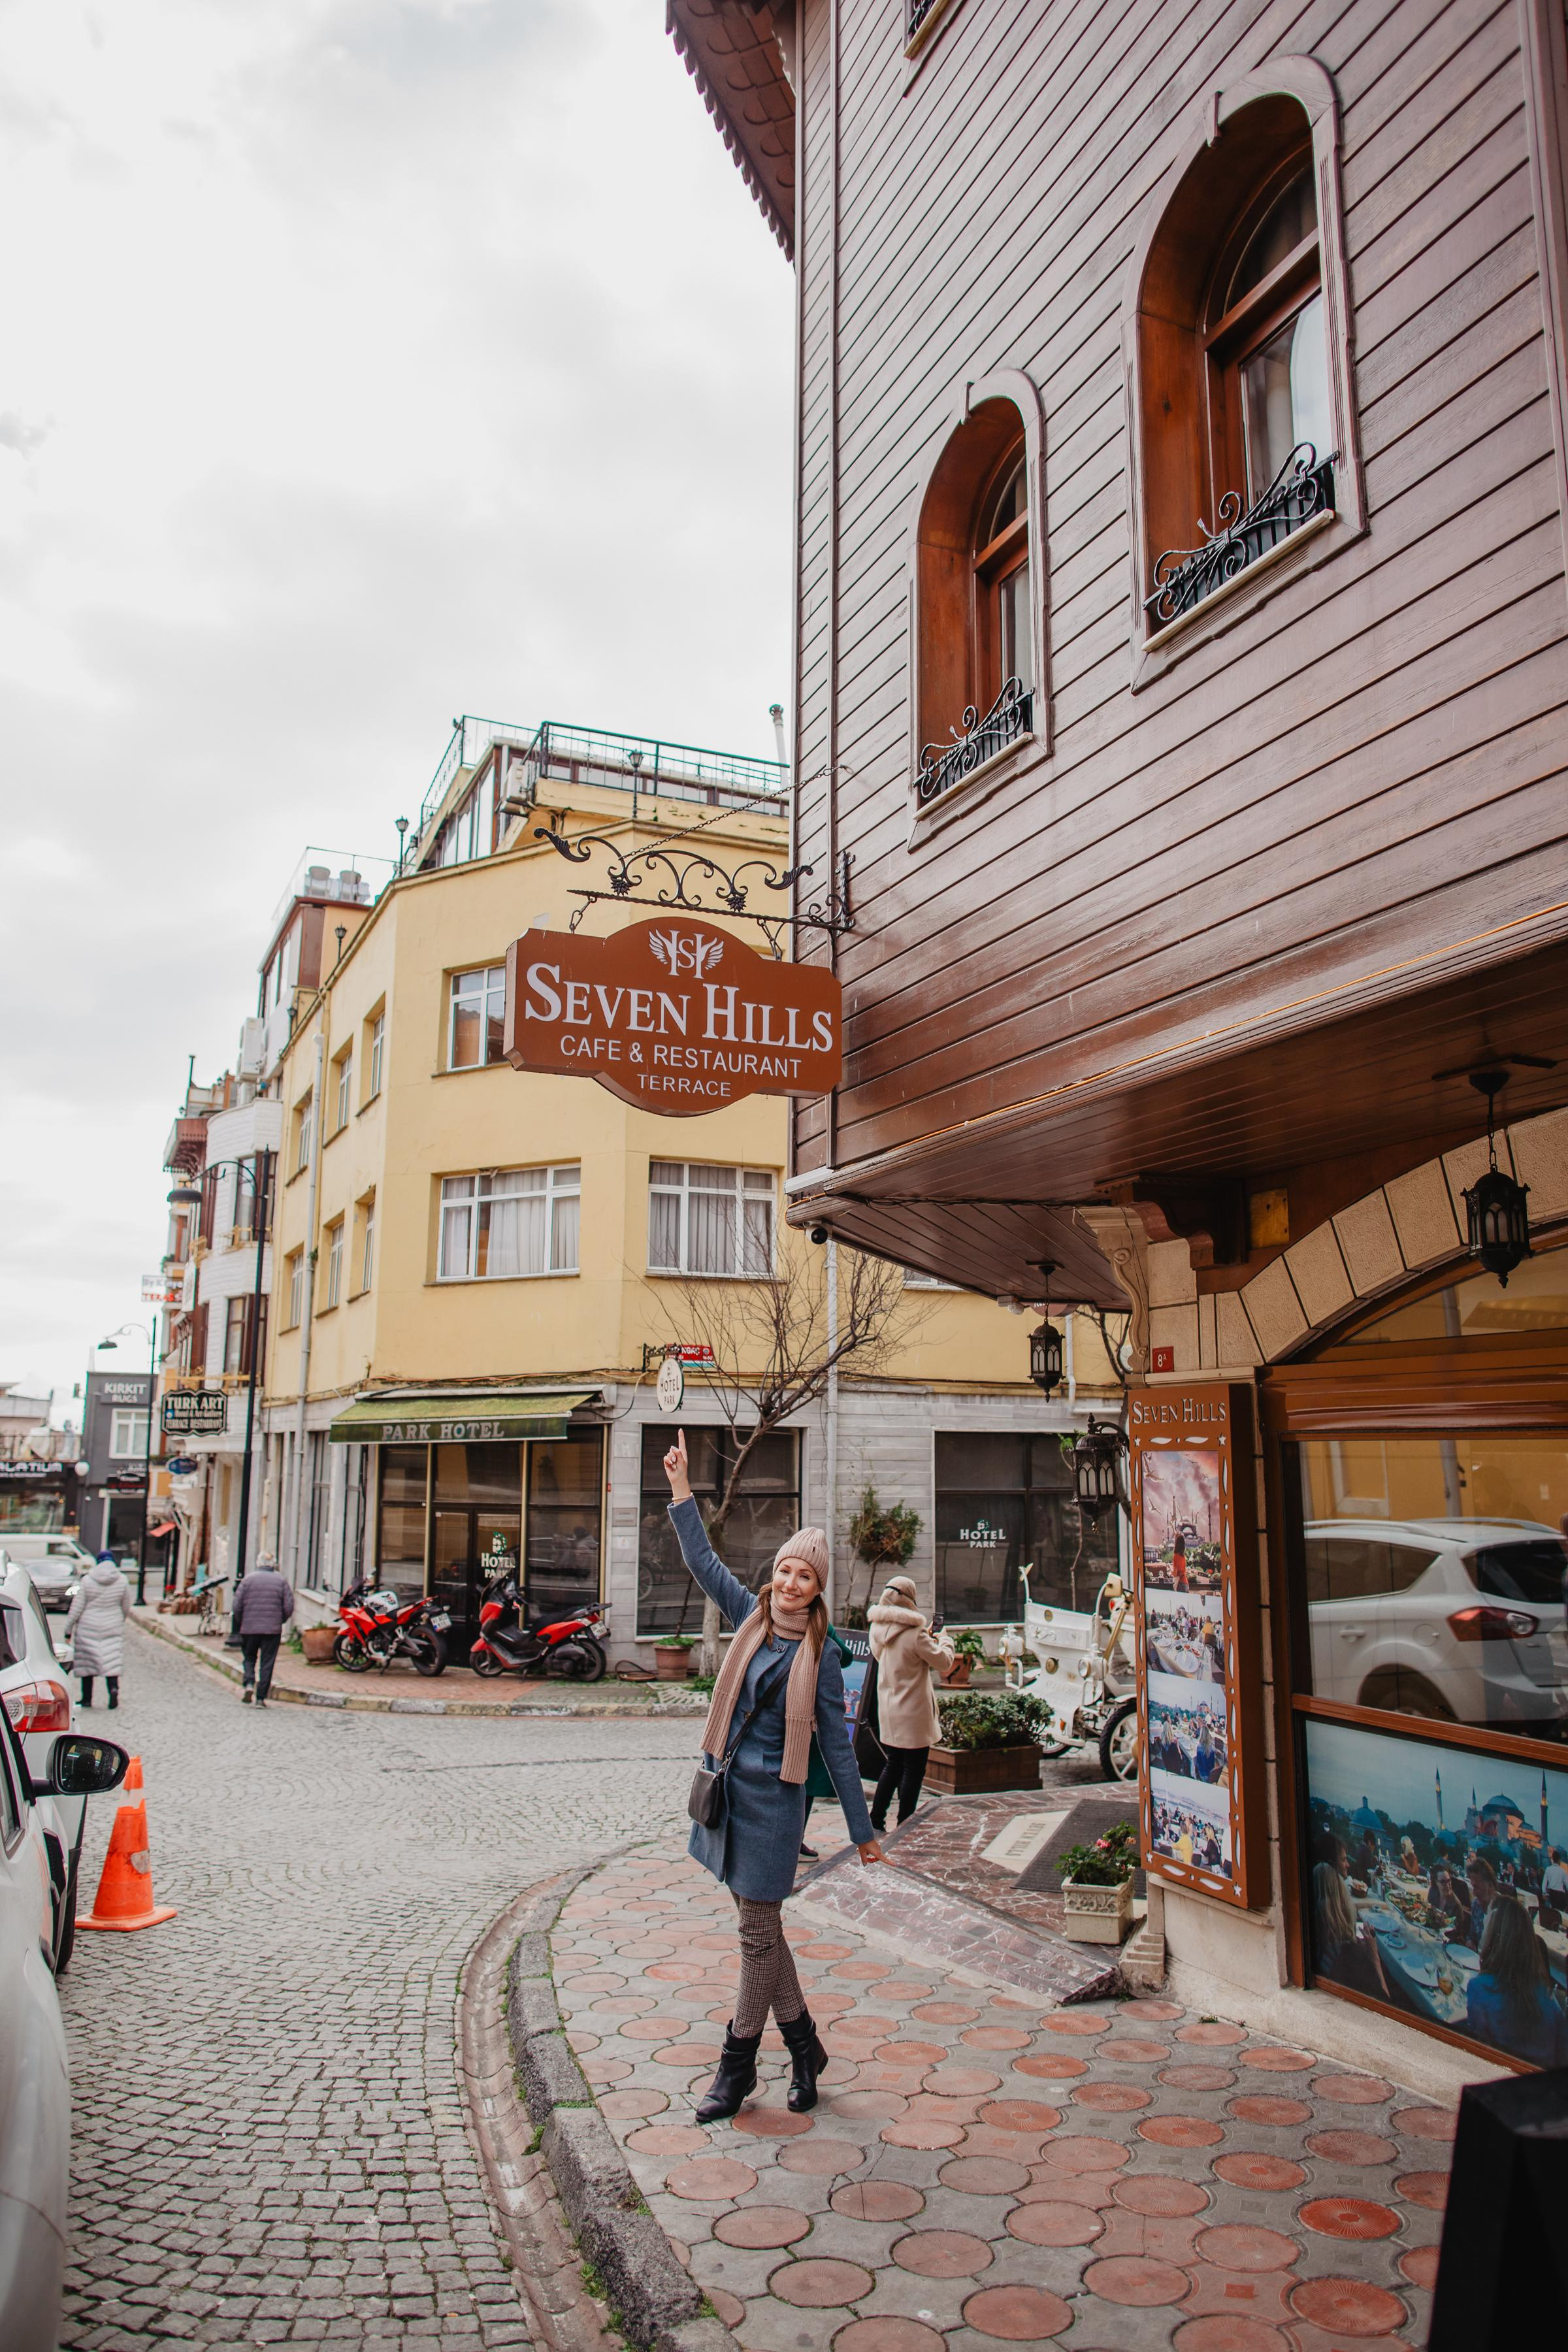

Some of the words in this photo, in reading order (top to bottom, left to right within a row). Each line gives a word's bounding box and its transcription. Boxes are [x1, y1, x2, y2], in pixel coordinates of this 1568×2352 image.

[525, 962, 691, 1036] SEVEN
[702, 983, 832, 1052] HILLS
[560, 1034, 621, 1061] CAFE
[629, 1041, 644, 1064] &
[654, 1045, 802, 1079] RESTAURANT
[637, 1073, 732, 1097] TERRACE
[105, 1382, 147, 1394] KIRKIT
[660, 1375, 679, 1393] HOTEL
[200, 1397, 223, 1409] ART
[664, 1395, 676, 1405] PARK
[1132, 1401, 1178, 1424] SEVEN
[1181, 1398, 1226, 1422] HILLS
[382, 1424, 431, 1441] PARK
[440, 1422, 504, 1439] HOTEL
[960, 1529, 1007, 1540] HOTEL
[481, 1552, 515, 1568] HOTEL
